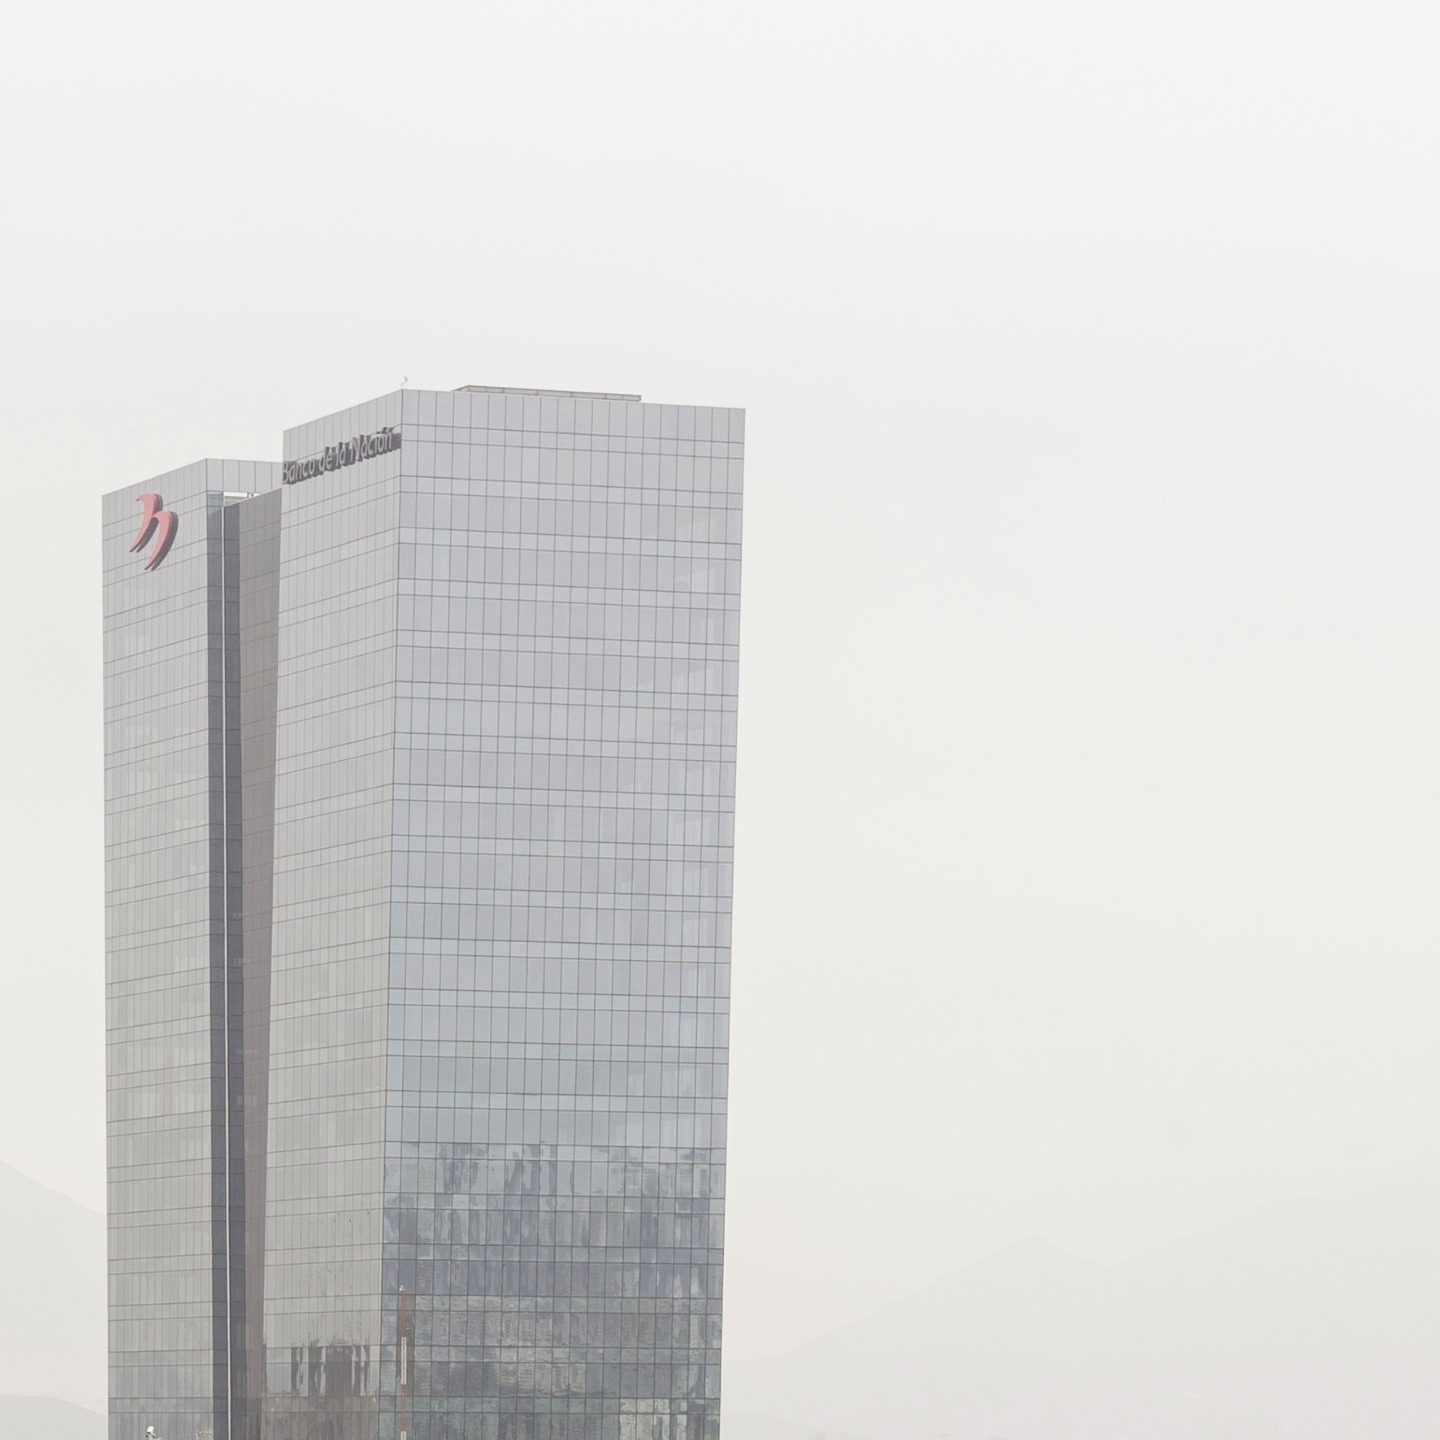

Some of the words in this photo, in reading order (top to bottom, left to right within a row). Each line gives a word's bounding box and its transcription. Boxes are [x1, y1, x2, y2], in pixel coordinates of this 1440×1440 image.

[282, 460, 318, 484] Banco
[319, 446, 334, 471] de
[350, 427, 397, 462] Nación
